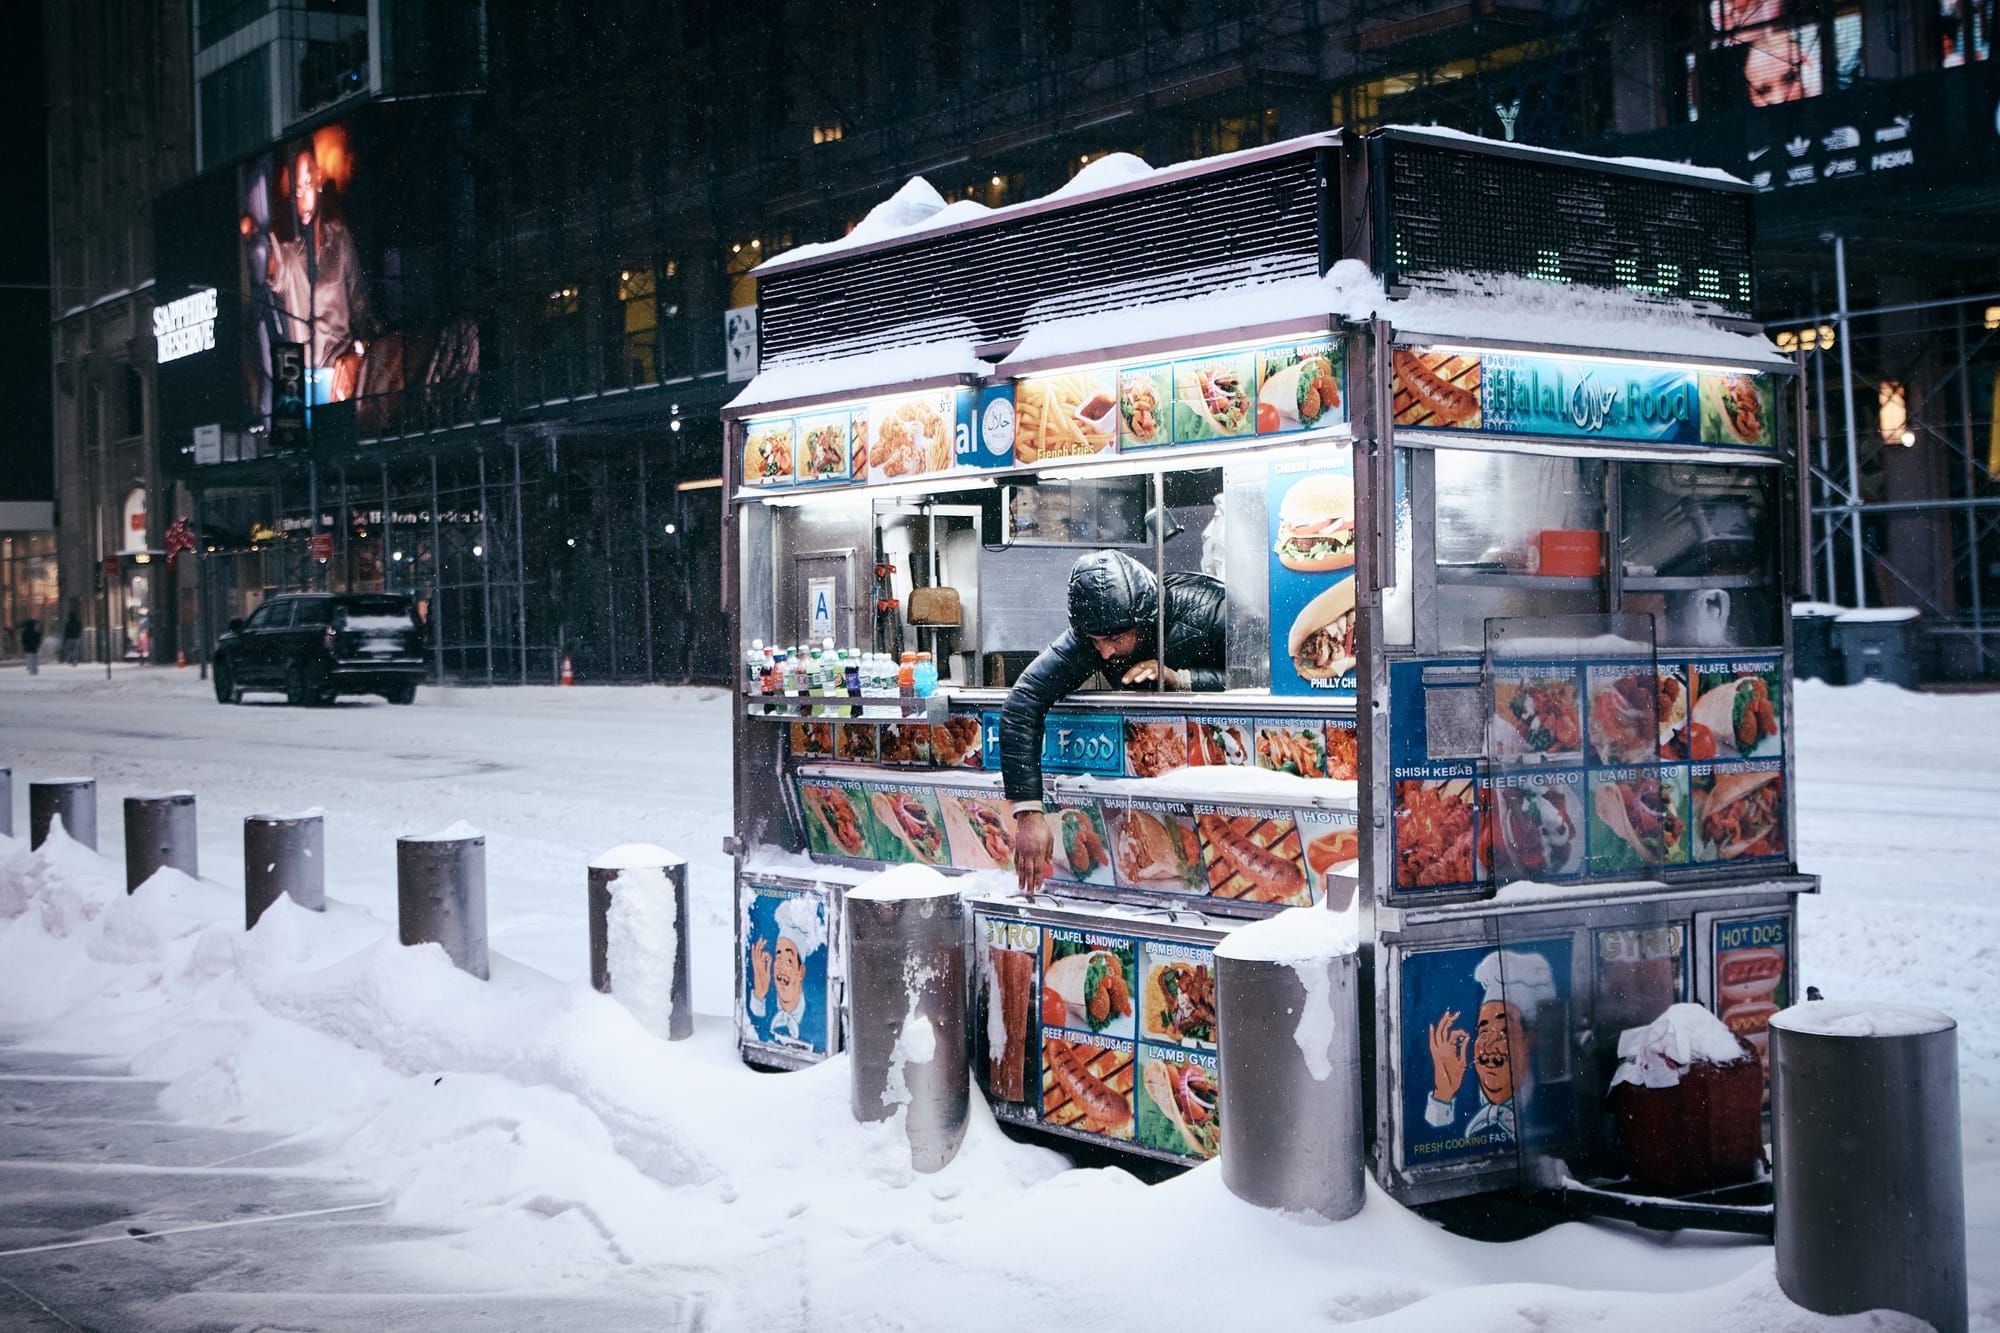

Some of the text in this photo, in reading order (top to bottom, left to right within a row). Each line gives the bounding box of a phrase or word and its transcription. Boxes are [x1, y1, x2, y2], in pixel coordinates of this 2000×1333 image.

[1297, 341, 1338, 355] SANDWICH
[1490, 366, 1565, 414] Halal
[1626, 376, 1690, 422] Food
[1037, 443, 1095, 460] French Fries
[815, 591, 829, 620] A
[1637, 665, 1655, 676] OVE
[1658, 665, 1680, 675] RICE
[1694, 663, 1774, 674] FALAFEL SANDWICH
[1311, 677, 1340, 689] PHILLY
[1195, 716, 1247, 726] BEEF GYRO
[1256, 718, 1320, 729] CHICKEN SALAD
[1056, 728, 1115, 760] Food
[1394, 767, 1473, 778] SHISH KEBAB
[1599, 766, 1680, 782] LAMB GYRO
[1691, 761, 1781, 777] BEEF ITALIAN SAUSAGE
[797, 778, 862, 791] CHICKEN GYRO
[1482, 772, 1580, 789] BEEF GYRO
[867, 782, 931, 797] LAMB GYRO
[940, 787, 976, 799] COMBO
[1054, 794, 1093, 807] SANDWICH
[1105, 798, 1187, 814] SHAWARMA ON PITA
[1193, 804, 1292, 821] BEEF ITALIAN SAUSAGE
[1303, 811, 1342, 825] HOT
[1049, 929, 1130, 950] FALAFEL SANDWICH
[1600, 926, 1680, 960] GYRO
[1721, 925, 1783, 948] HOT DOG
[1145, 942, 1173, 956] LAMB
[1175, 946, 1203, 961] OVER
[1043, 1027, 1133, 1053] BEEF ITALIAN SAUSAGE
[1149, 1046, 1185, 1063] LAMB
[1414, 1142, 1443, 1155] FRESH
[1445, 1135, 1488, 1150] COOKING
